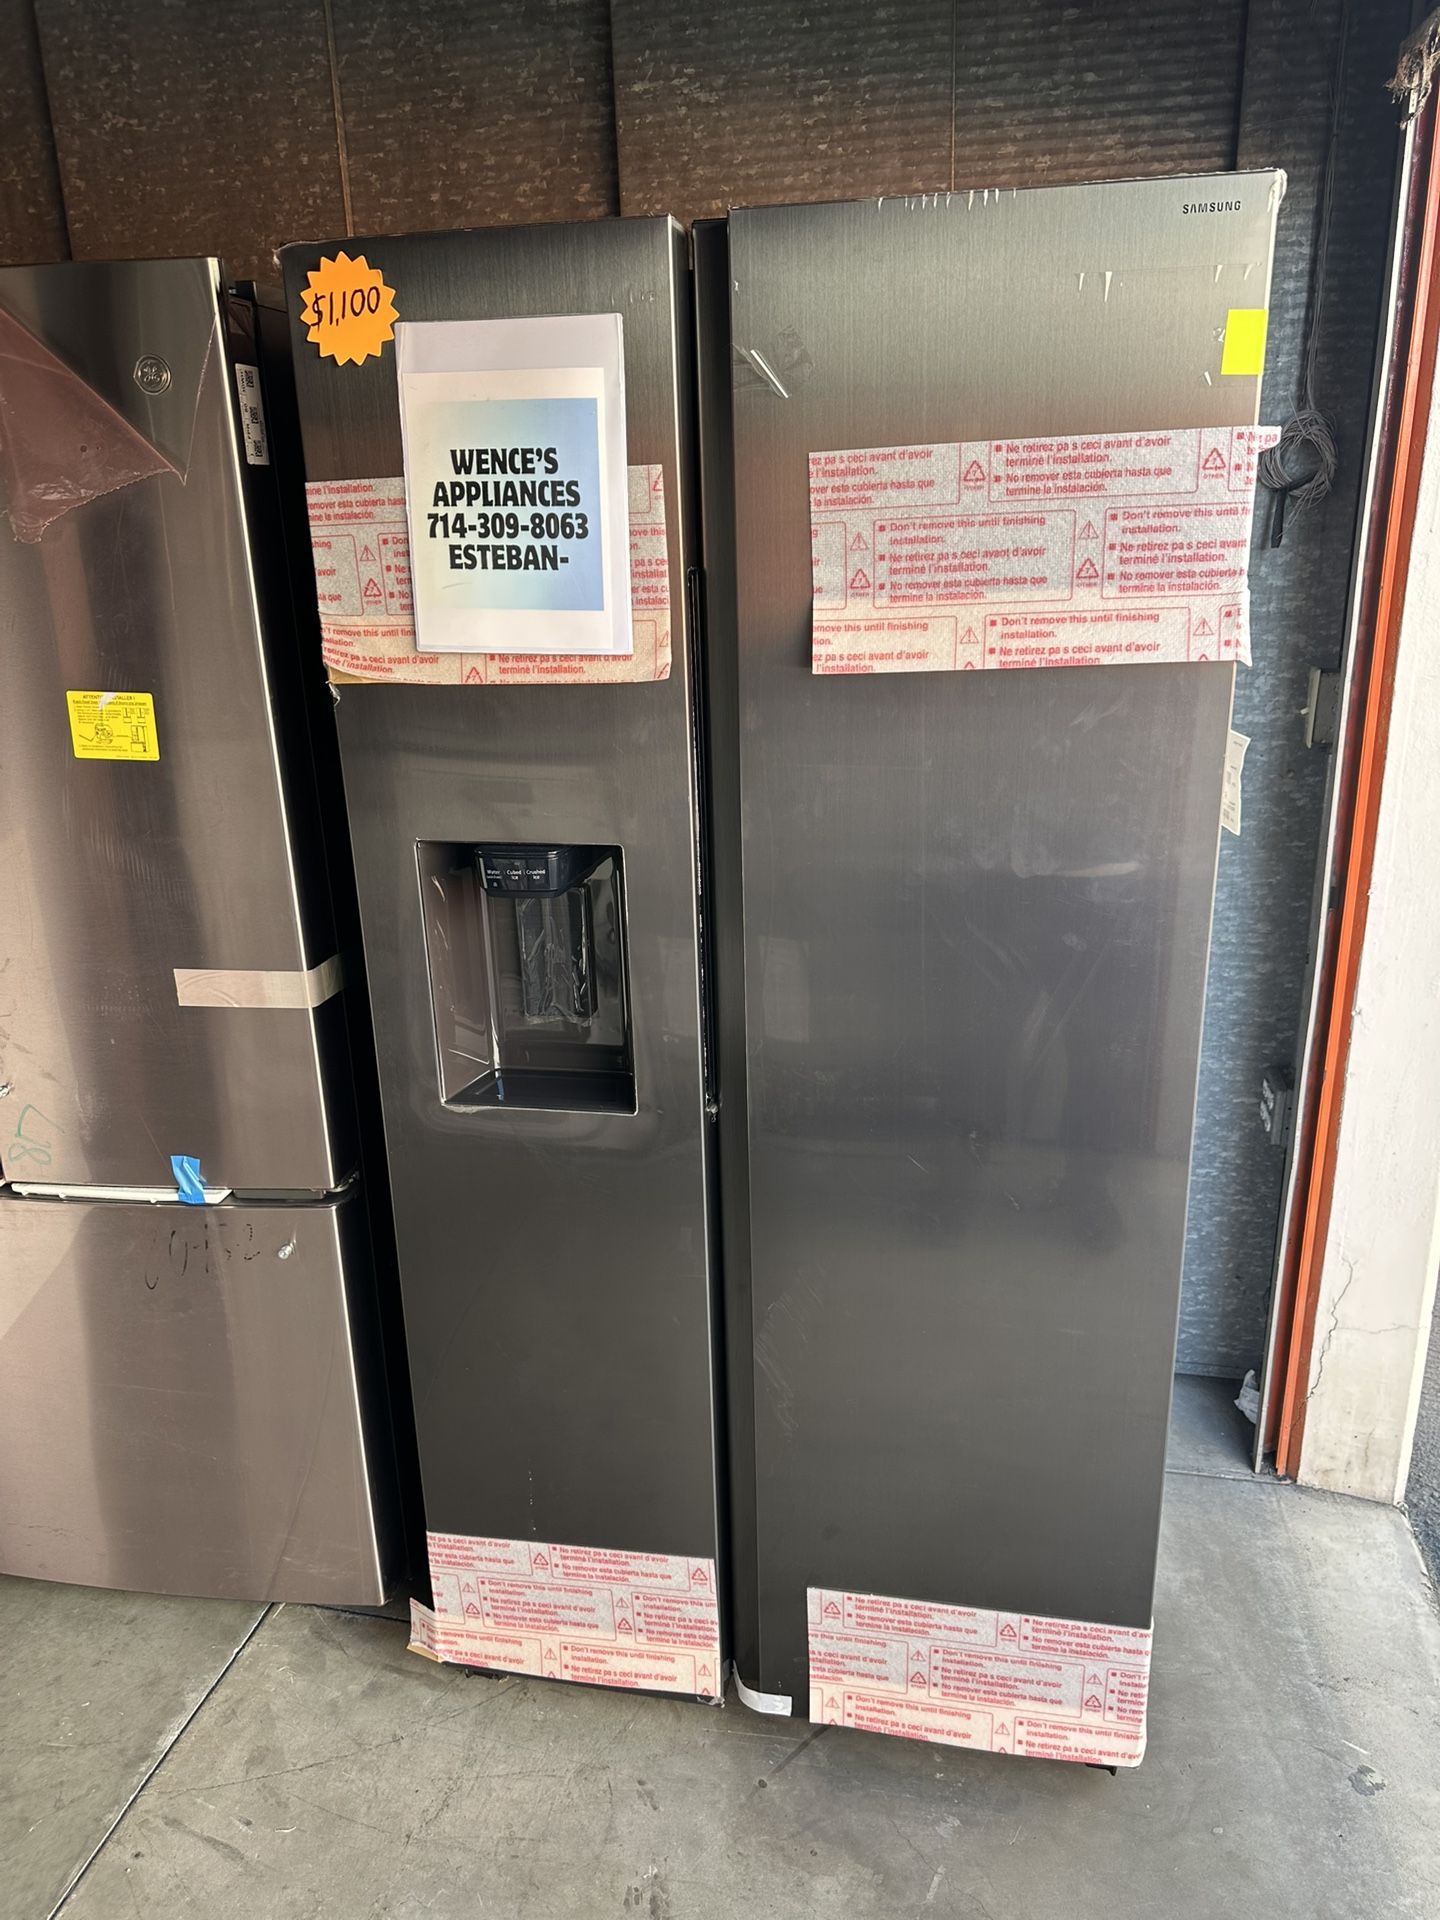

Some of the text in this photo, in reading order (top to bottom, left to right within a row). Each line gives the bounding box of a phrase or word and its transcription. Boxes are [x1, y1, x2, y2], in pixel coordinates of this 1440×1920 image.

[1182, 200, 1241, 214] SAMSUNG
[310, 286, 380, 332] $1,100
[449, 447, 559, 476] WENCE'S
[432, 480, 581, 508] APPLIANCES
[427, 512, 589, 540] 714-309-8063
[448, 544, 569, 570] ESTEBAN-
